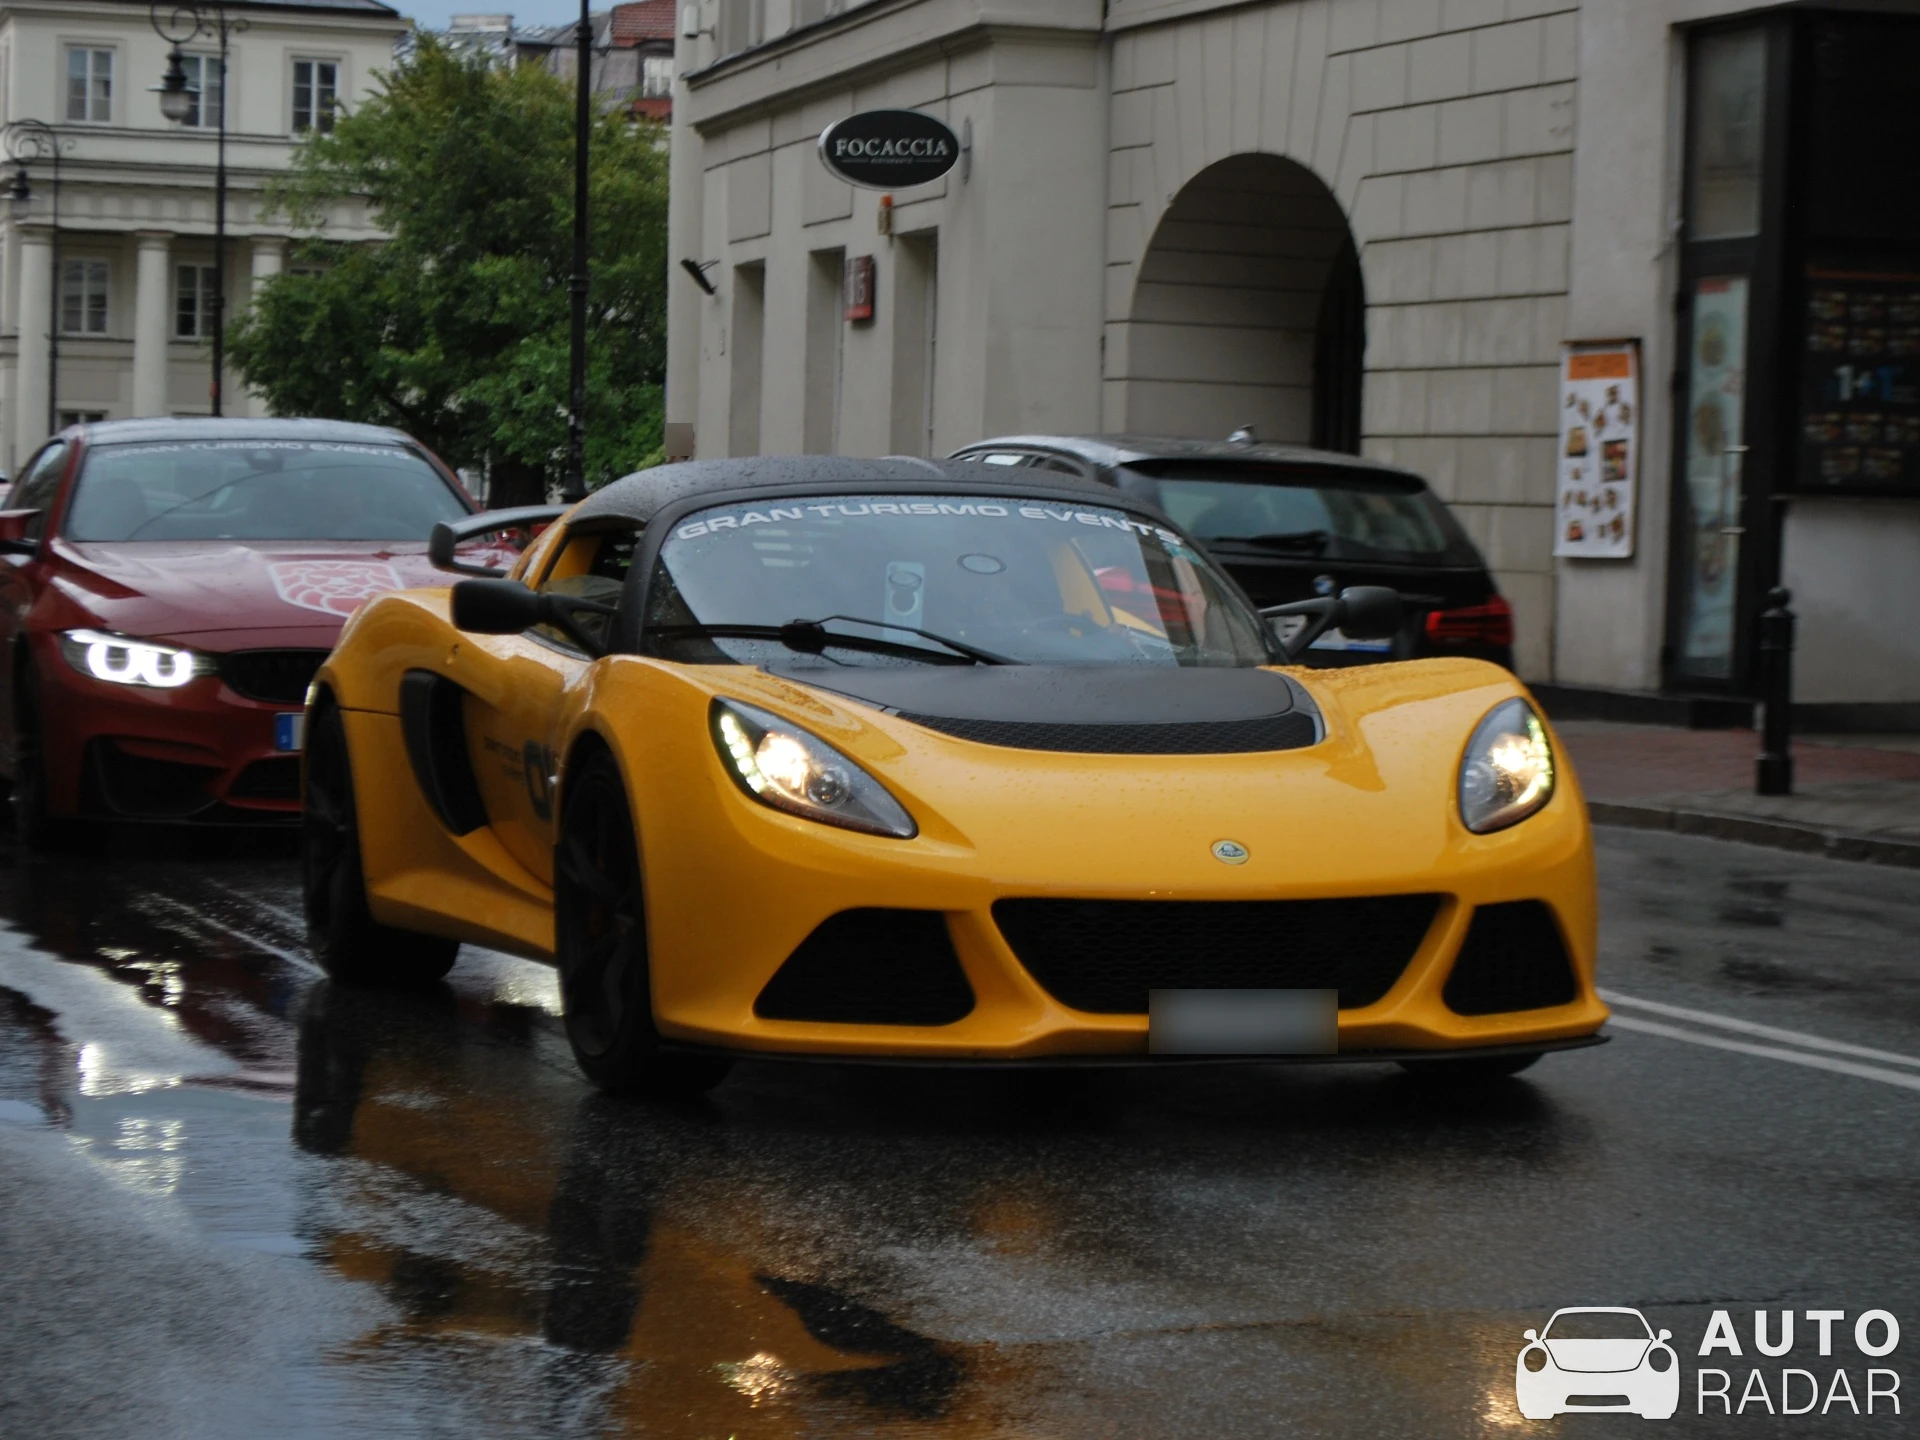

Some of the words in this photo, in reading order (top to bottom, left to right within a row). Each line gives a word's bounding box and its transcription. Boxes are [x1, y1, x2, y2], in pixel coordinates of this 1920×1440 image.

[835, 137, 948, 156] FOCACCIA
[105, 445, 180, 459] GRAN
[188, 441, 304, 451] TURISMO
[309, 443, 411, 460] EVENTS
[676, 507, 802, 541] GRAN
[805, 502, 1009, 519] TURISMO
[1019, 506, 1183, 546] EVENTS
